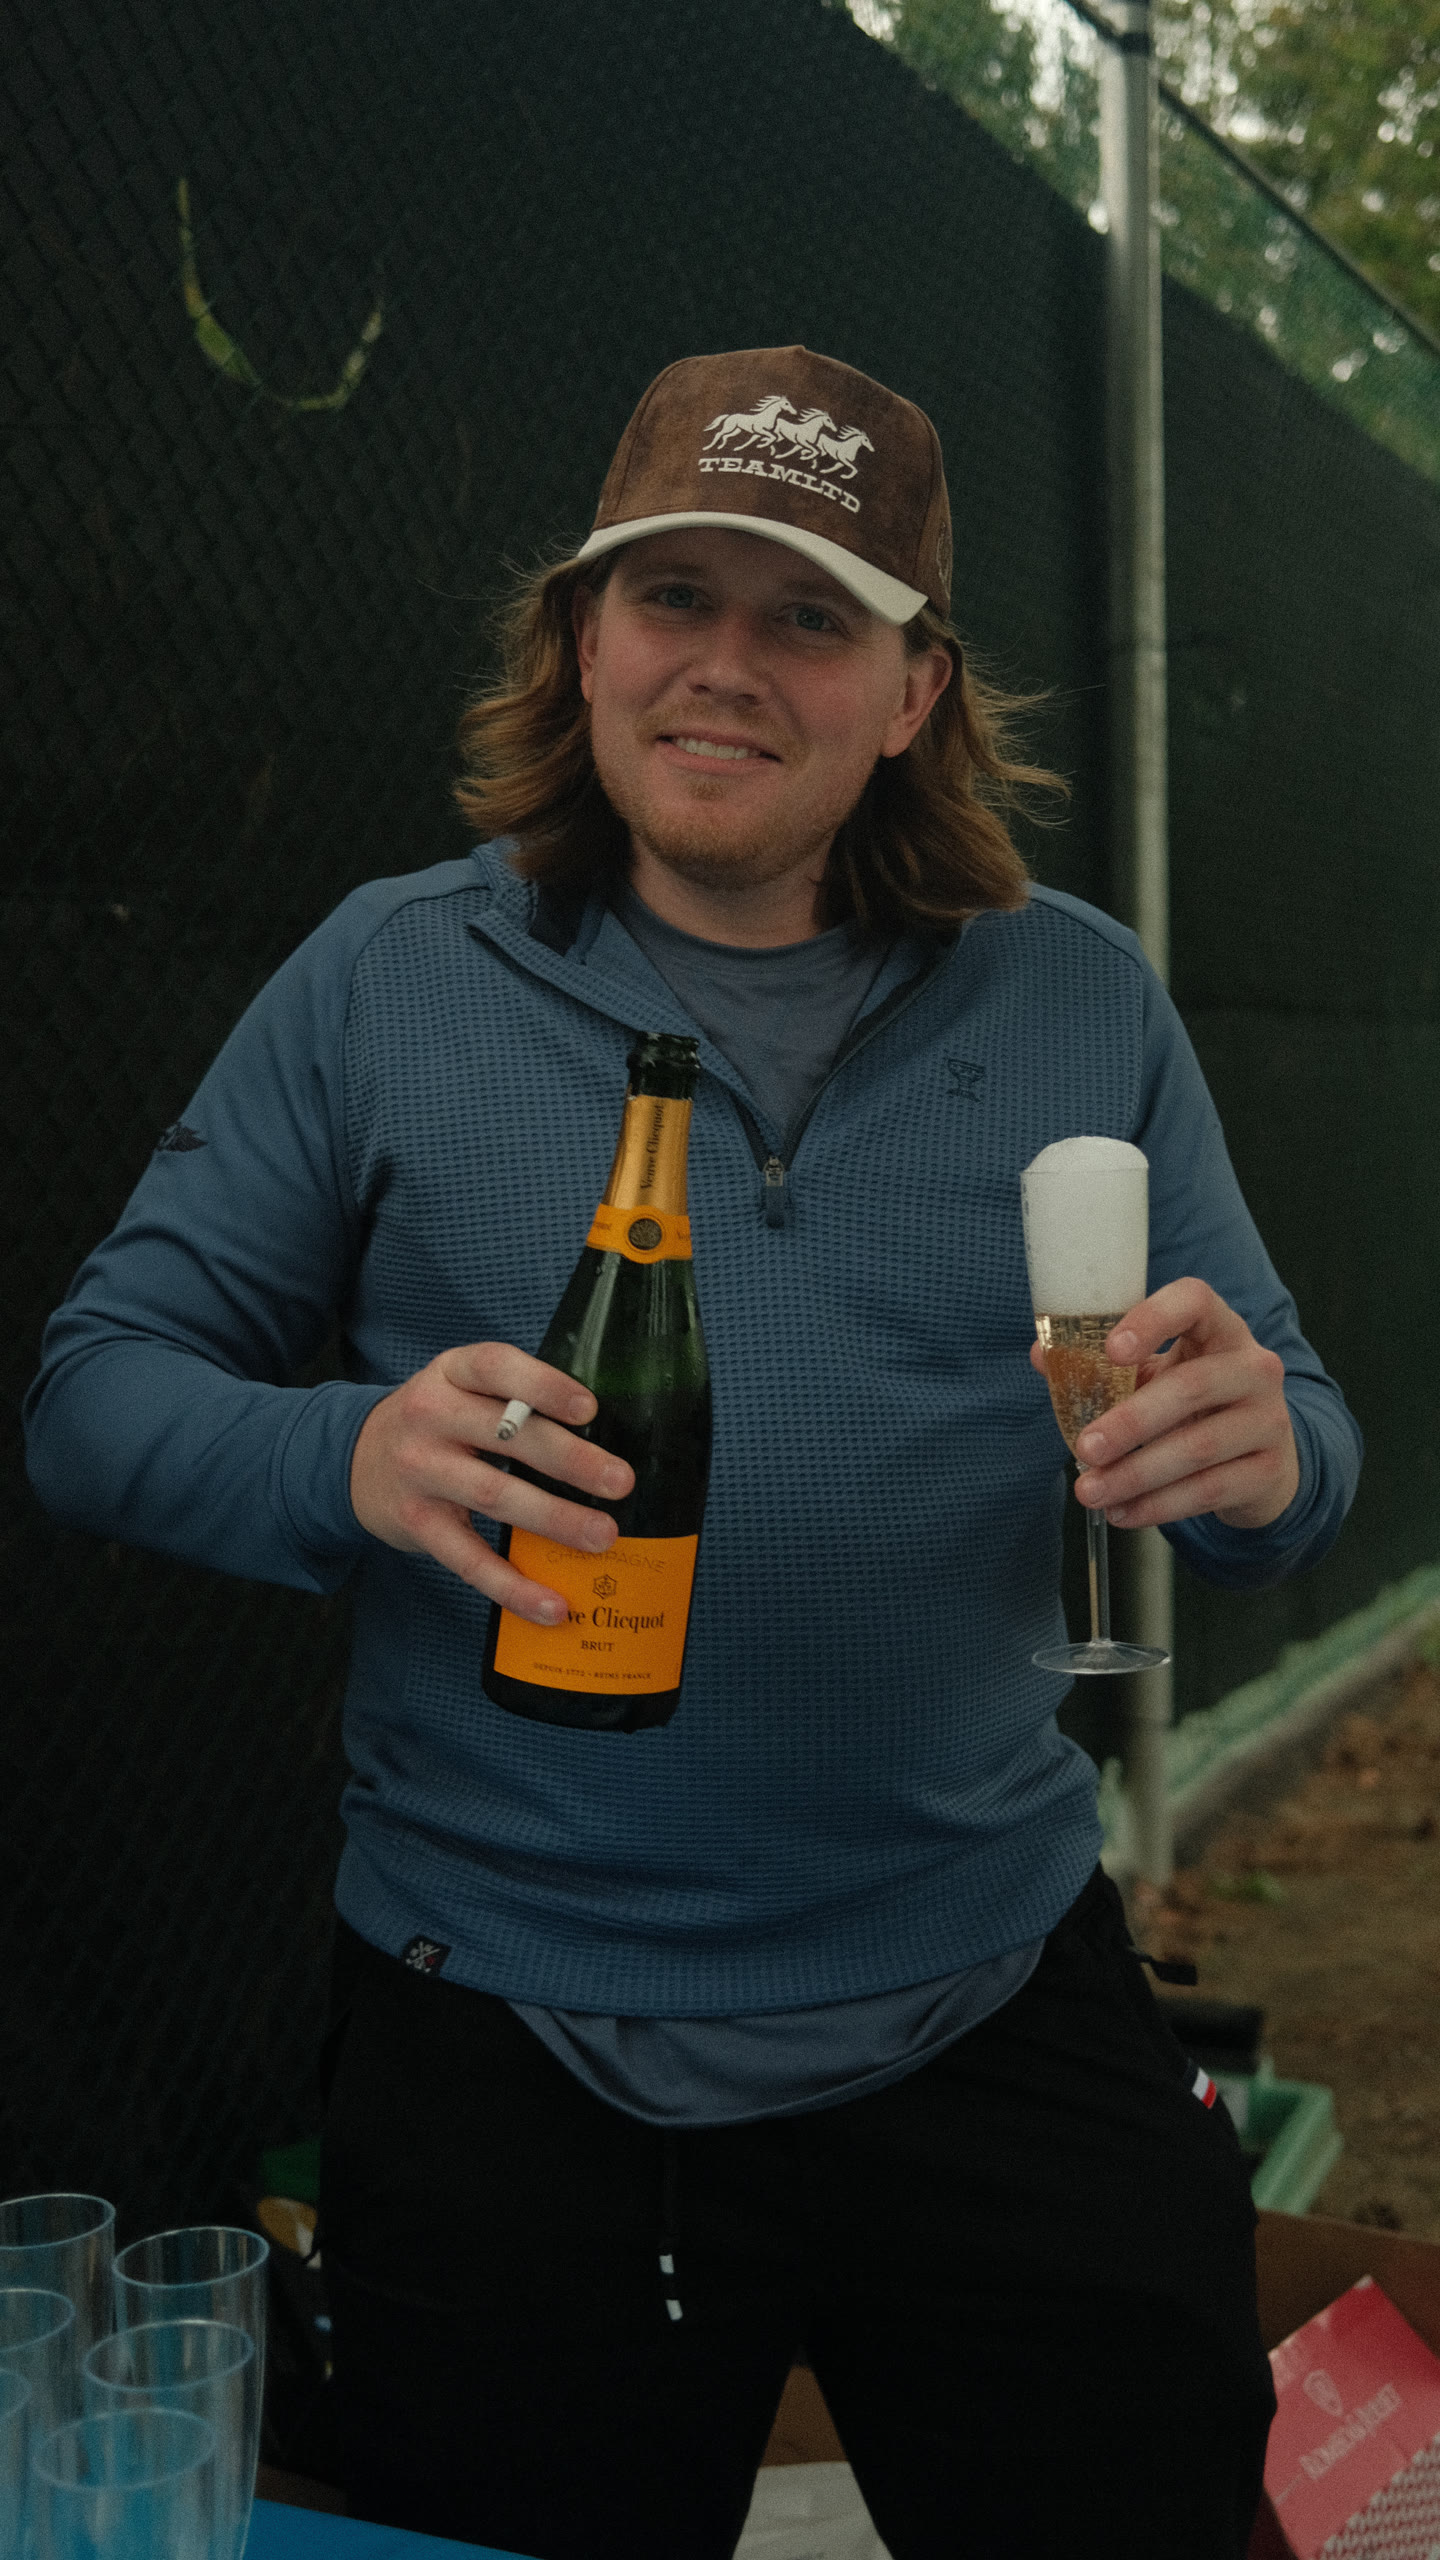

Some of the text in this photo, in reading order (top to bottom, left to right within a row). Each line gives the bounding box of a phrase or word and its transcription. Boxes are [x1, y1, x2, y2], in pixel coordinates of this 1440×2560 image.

[698, 457, 861, 513] TEAMLTD
[641, 1104, 665, 1189] Veuve Clicquot
[546, 1549, 665, 1574] CHAMPAGNE
[592, 1606, 665, 1633] Clicquot
[580, 1639, 615, 1652] BRUT
